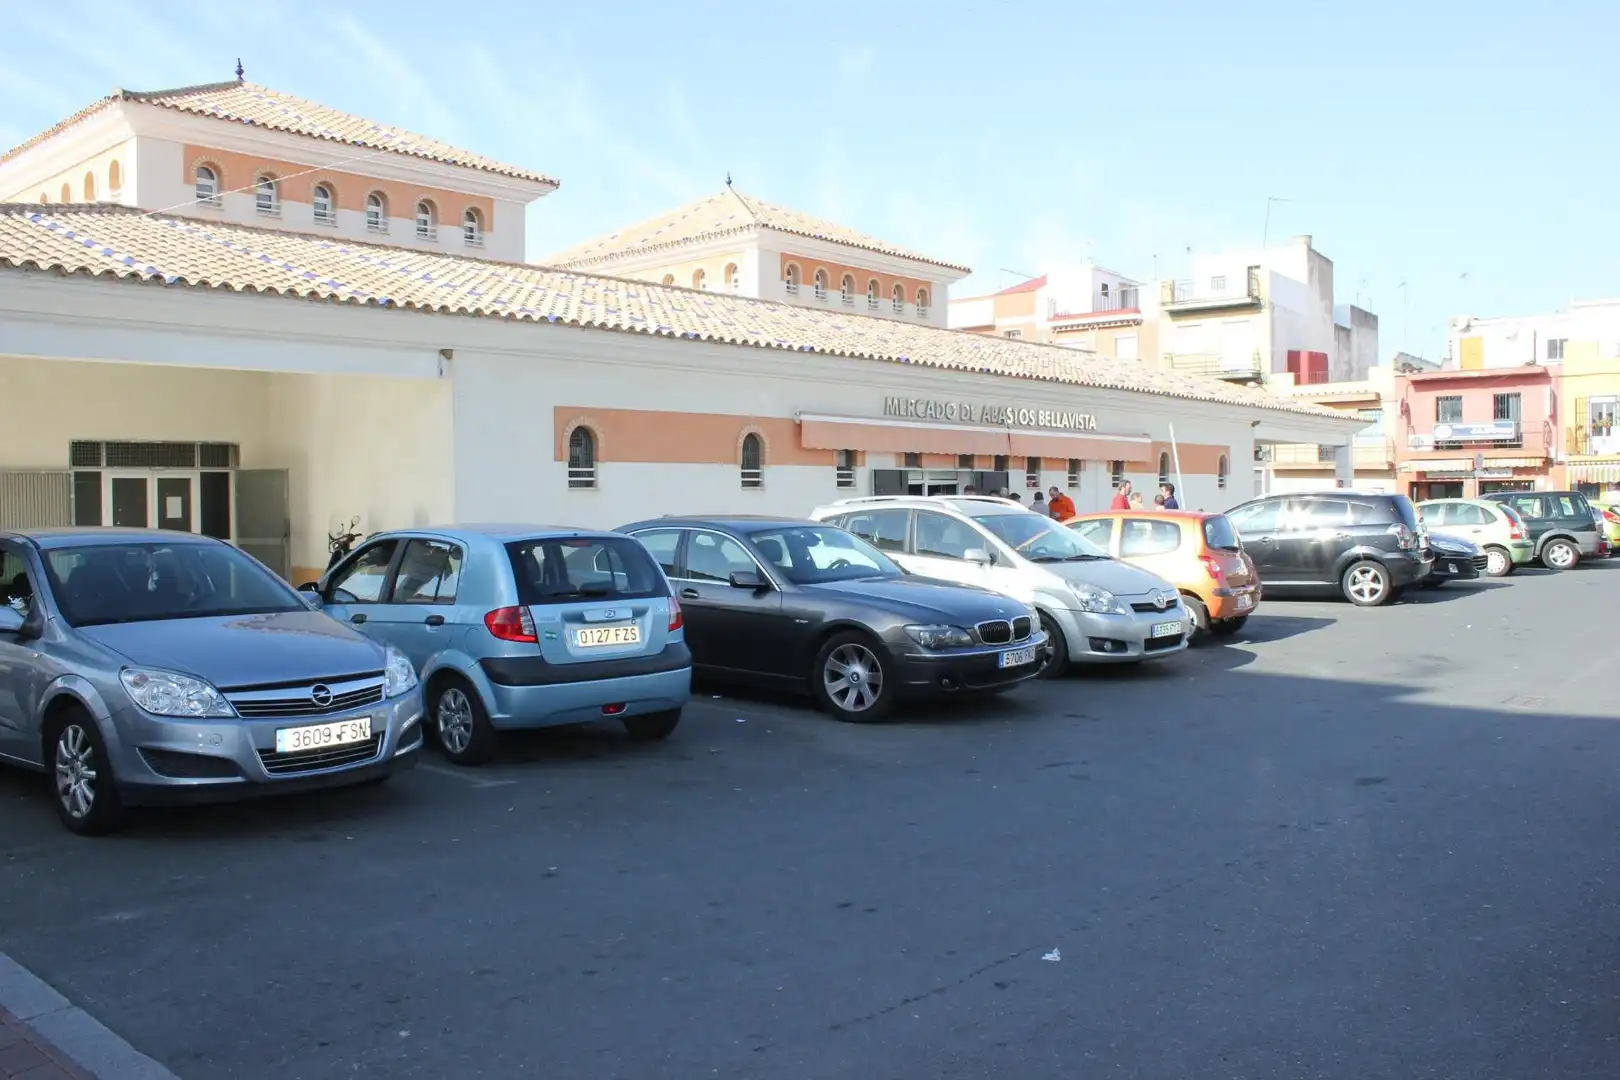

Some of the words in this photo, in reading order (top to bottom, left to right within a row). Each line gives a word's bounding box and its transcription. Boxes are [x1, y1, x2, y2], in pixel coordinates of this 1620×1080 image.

[884, 396, 957, 421] MERCADO
[958, 403, 975, 422] DE
[980, 404, 1036, 427] ABASTOS
[1038, 409, 1097, 430] BELLAVISTA
[580, 629, 610, 644] 0127
[615, 627, 637, 641] FZS
[292, 727, 332, 748] 3609
[339, 721, 369, 742] FSN
